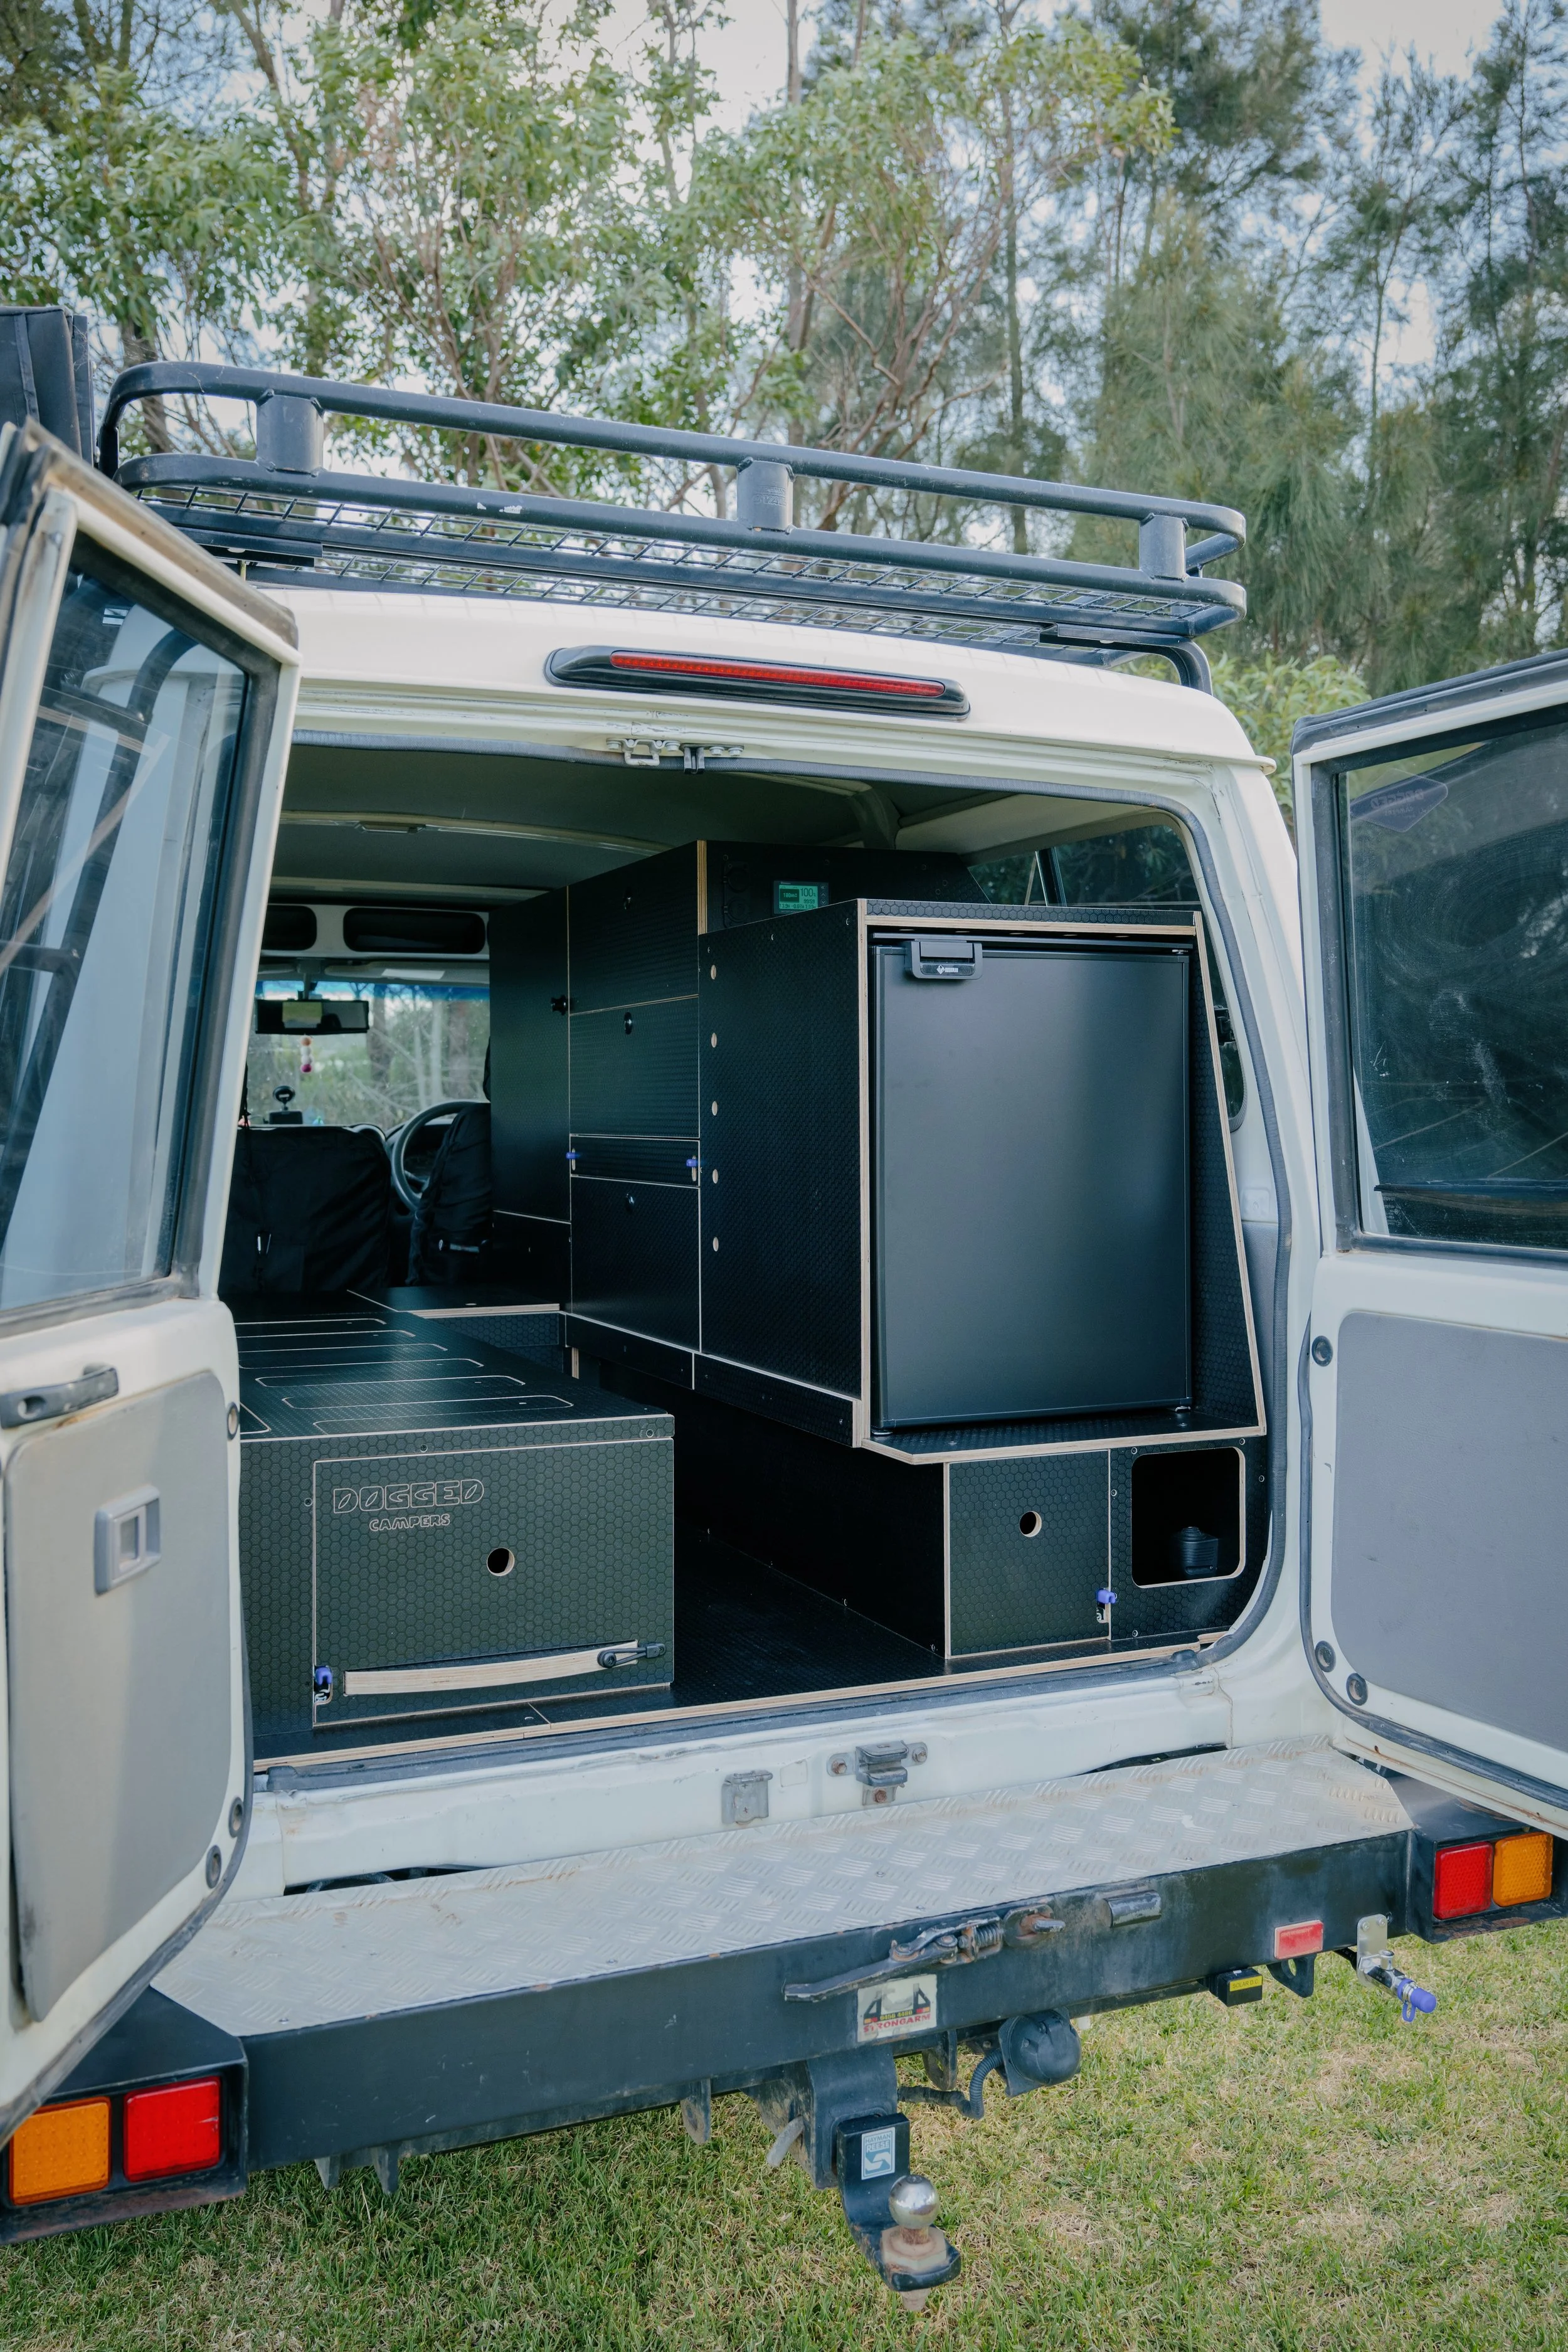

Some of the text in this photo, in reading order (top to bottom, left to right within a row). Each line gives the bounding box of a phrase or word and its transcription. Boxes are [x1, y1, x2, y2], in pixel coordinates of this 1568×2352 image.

[334, 1479, 484, 1513] DOGGED
[369, 1513, 450, 1531] CAMPERS
[1232, 1981, 1249, 1989] SOLAR
[866, 2133, 891, 2144] HAYMAN
[866, 2140, 890, 2153] REESE
